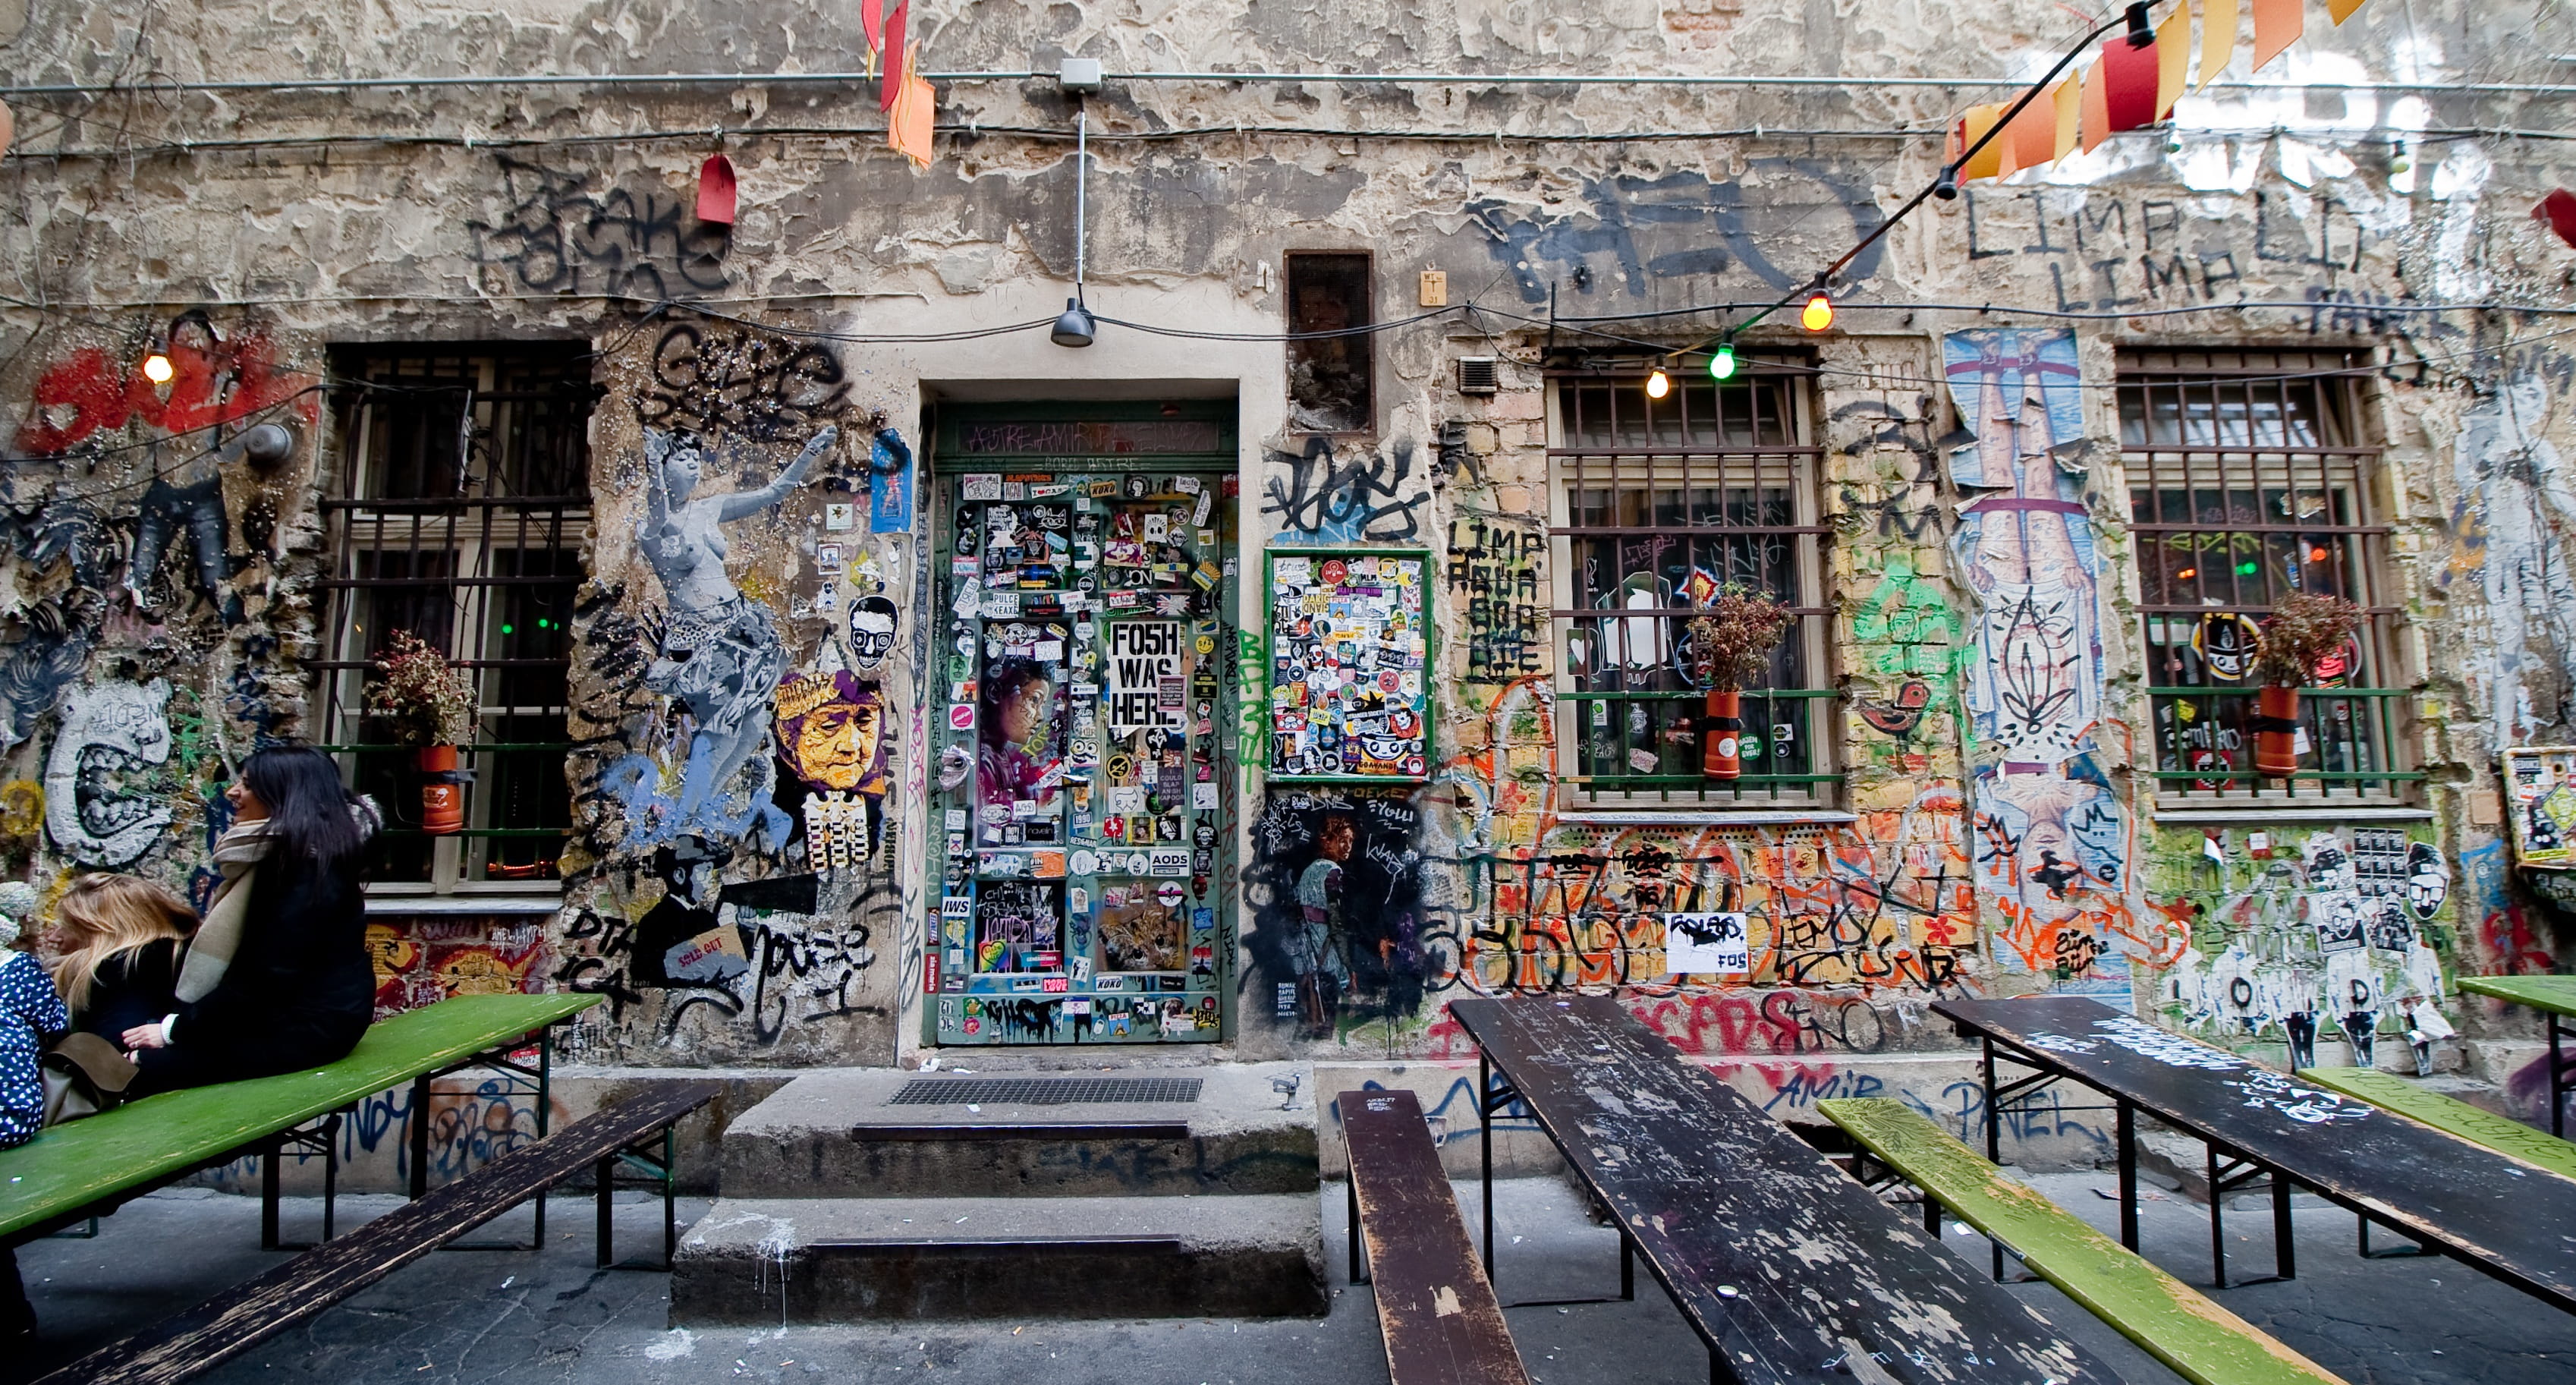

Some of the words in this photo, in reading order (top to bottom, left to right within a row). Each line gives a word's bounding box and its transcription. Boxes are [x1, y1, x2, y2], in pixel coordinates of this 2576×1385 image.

[1092, 483, 1115, 495] KOKO
[1118, 658, 1172, 689] WAS
[1074, 814, 1091, 825] 1990
[1152, 855, 1188, 864] AODS
[943, 899, 969, 912] IWS
[678, 948, 703, 968] SOLD
[703, 936, 723, 958] OUT
[1097, 979, 1122, 989] KOKO
